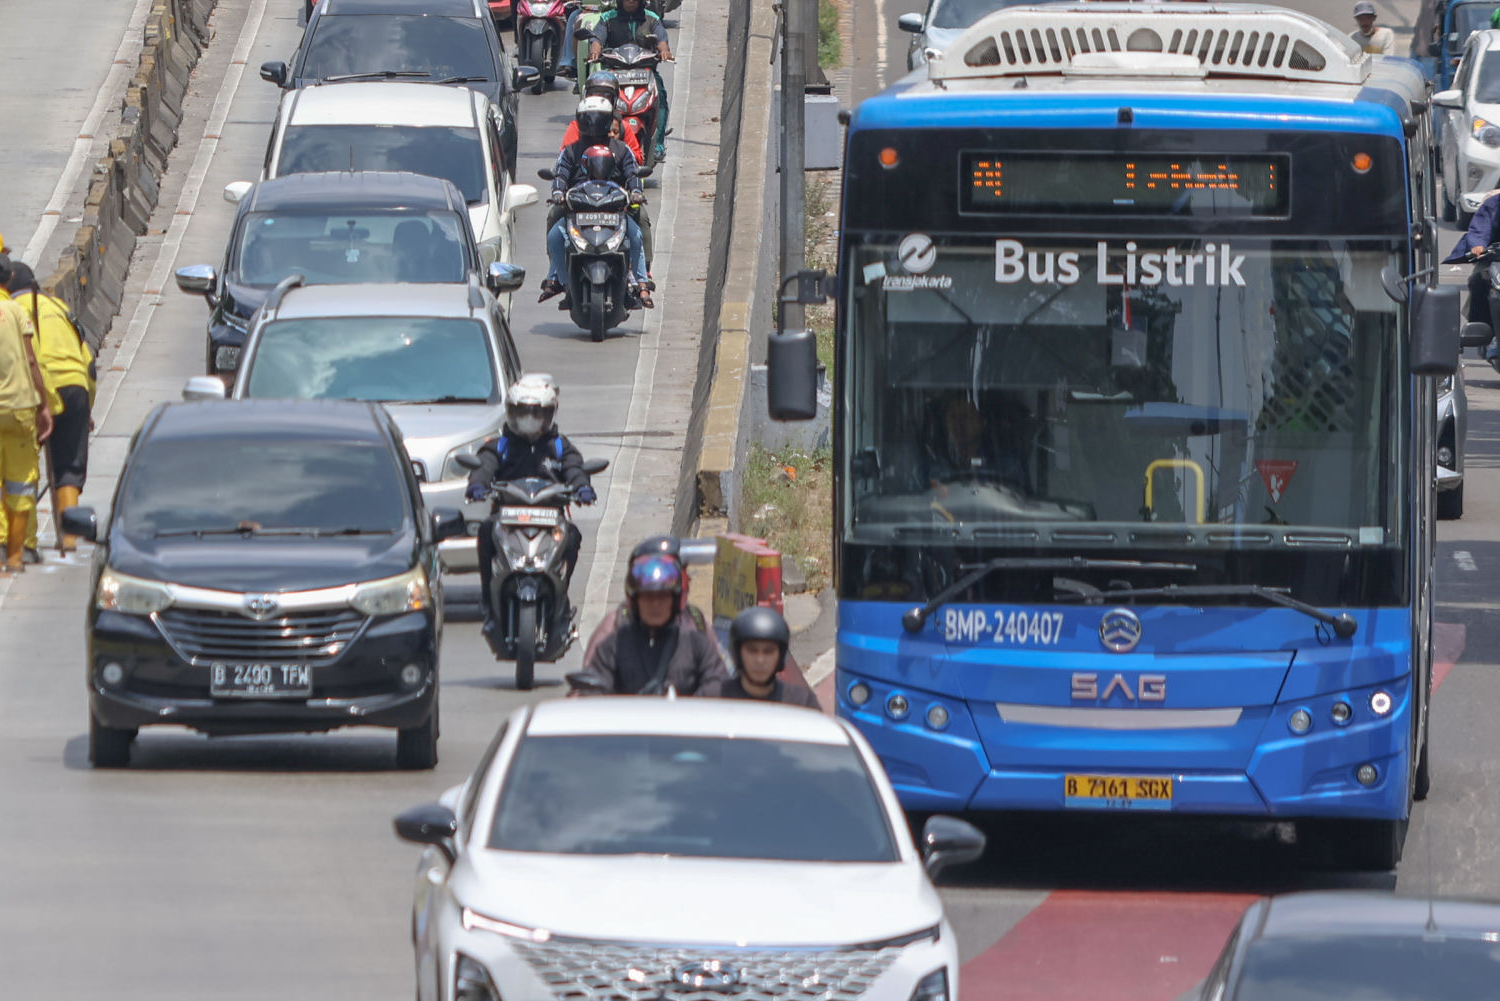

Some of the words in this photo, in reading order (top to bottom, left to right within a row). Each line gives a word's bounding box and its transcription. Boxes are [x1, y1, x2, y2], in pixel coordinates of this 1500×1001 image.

[994, 239, 1080, 284] Bus
[1097, 241, 1247, 287] Listrik
[882, 274, 952, 291] transjakarta
[945, 609, 1064, 645] BMP-240407
[214, 664, 226, 685] B
[280, 664, 310, 685] TFW
[1071, 672, 1167, 700] SAG
[1067, 778, 1078, 797] B
[1088, 778, 1129, 798] 7161
[1136, 780, 1170, 800] SGX
